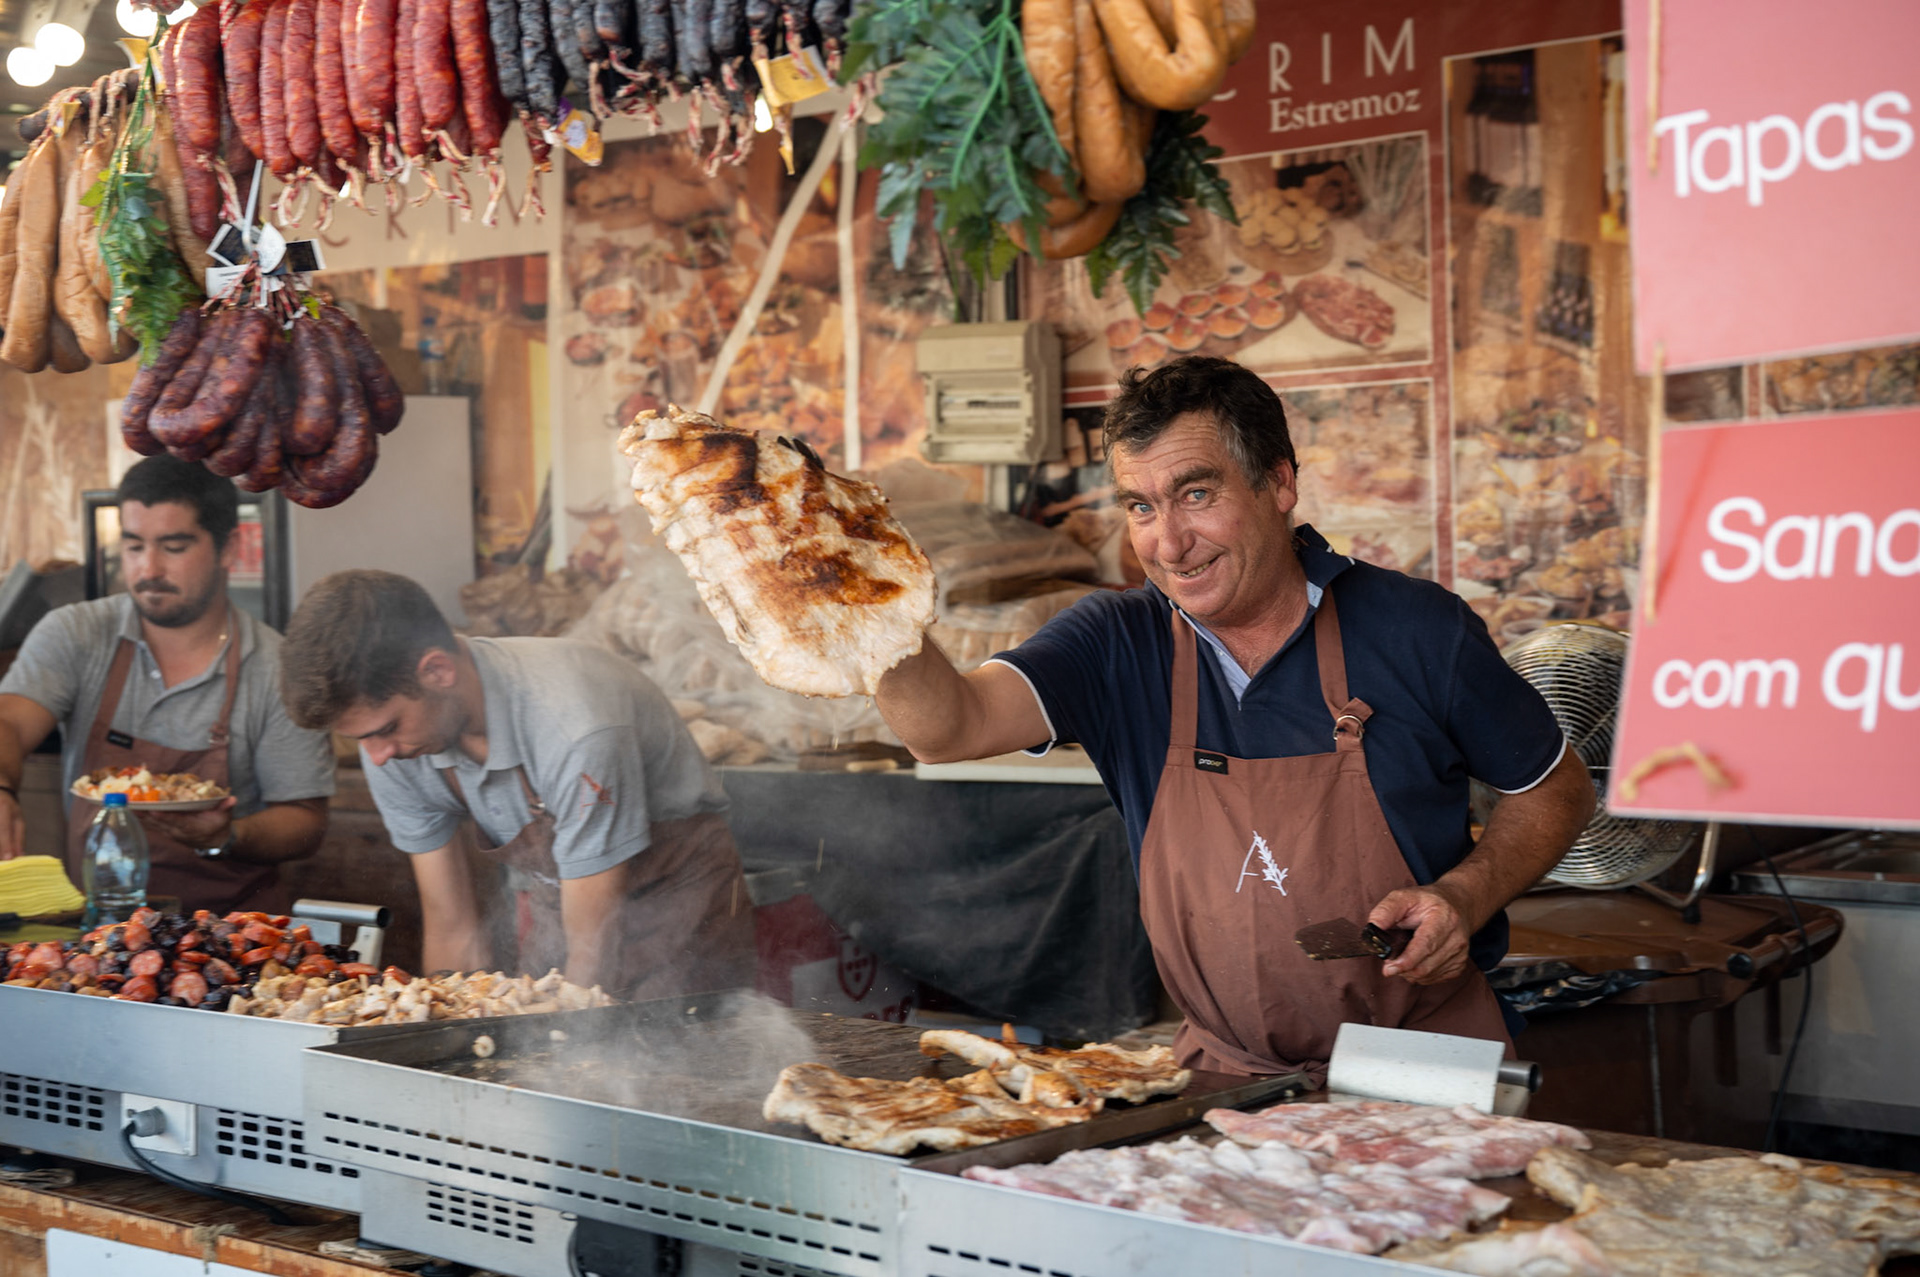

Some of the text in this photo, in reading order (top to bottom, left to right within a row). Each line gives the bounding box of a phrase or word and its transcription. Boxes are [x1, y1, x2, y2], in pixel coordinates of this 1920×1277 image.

[1211, 17, 1416, 102] RIM
[1269, 88, 1422, 133] Estremoz
[1653, 90, 1915, 207] Tapas
[1652, 658, 1800, 709] com
